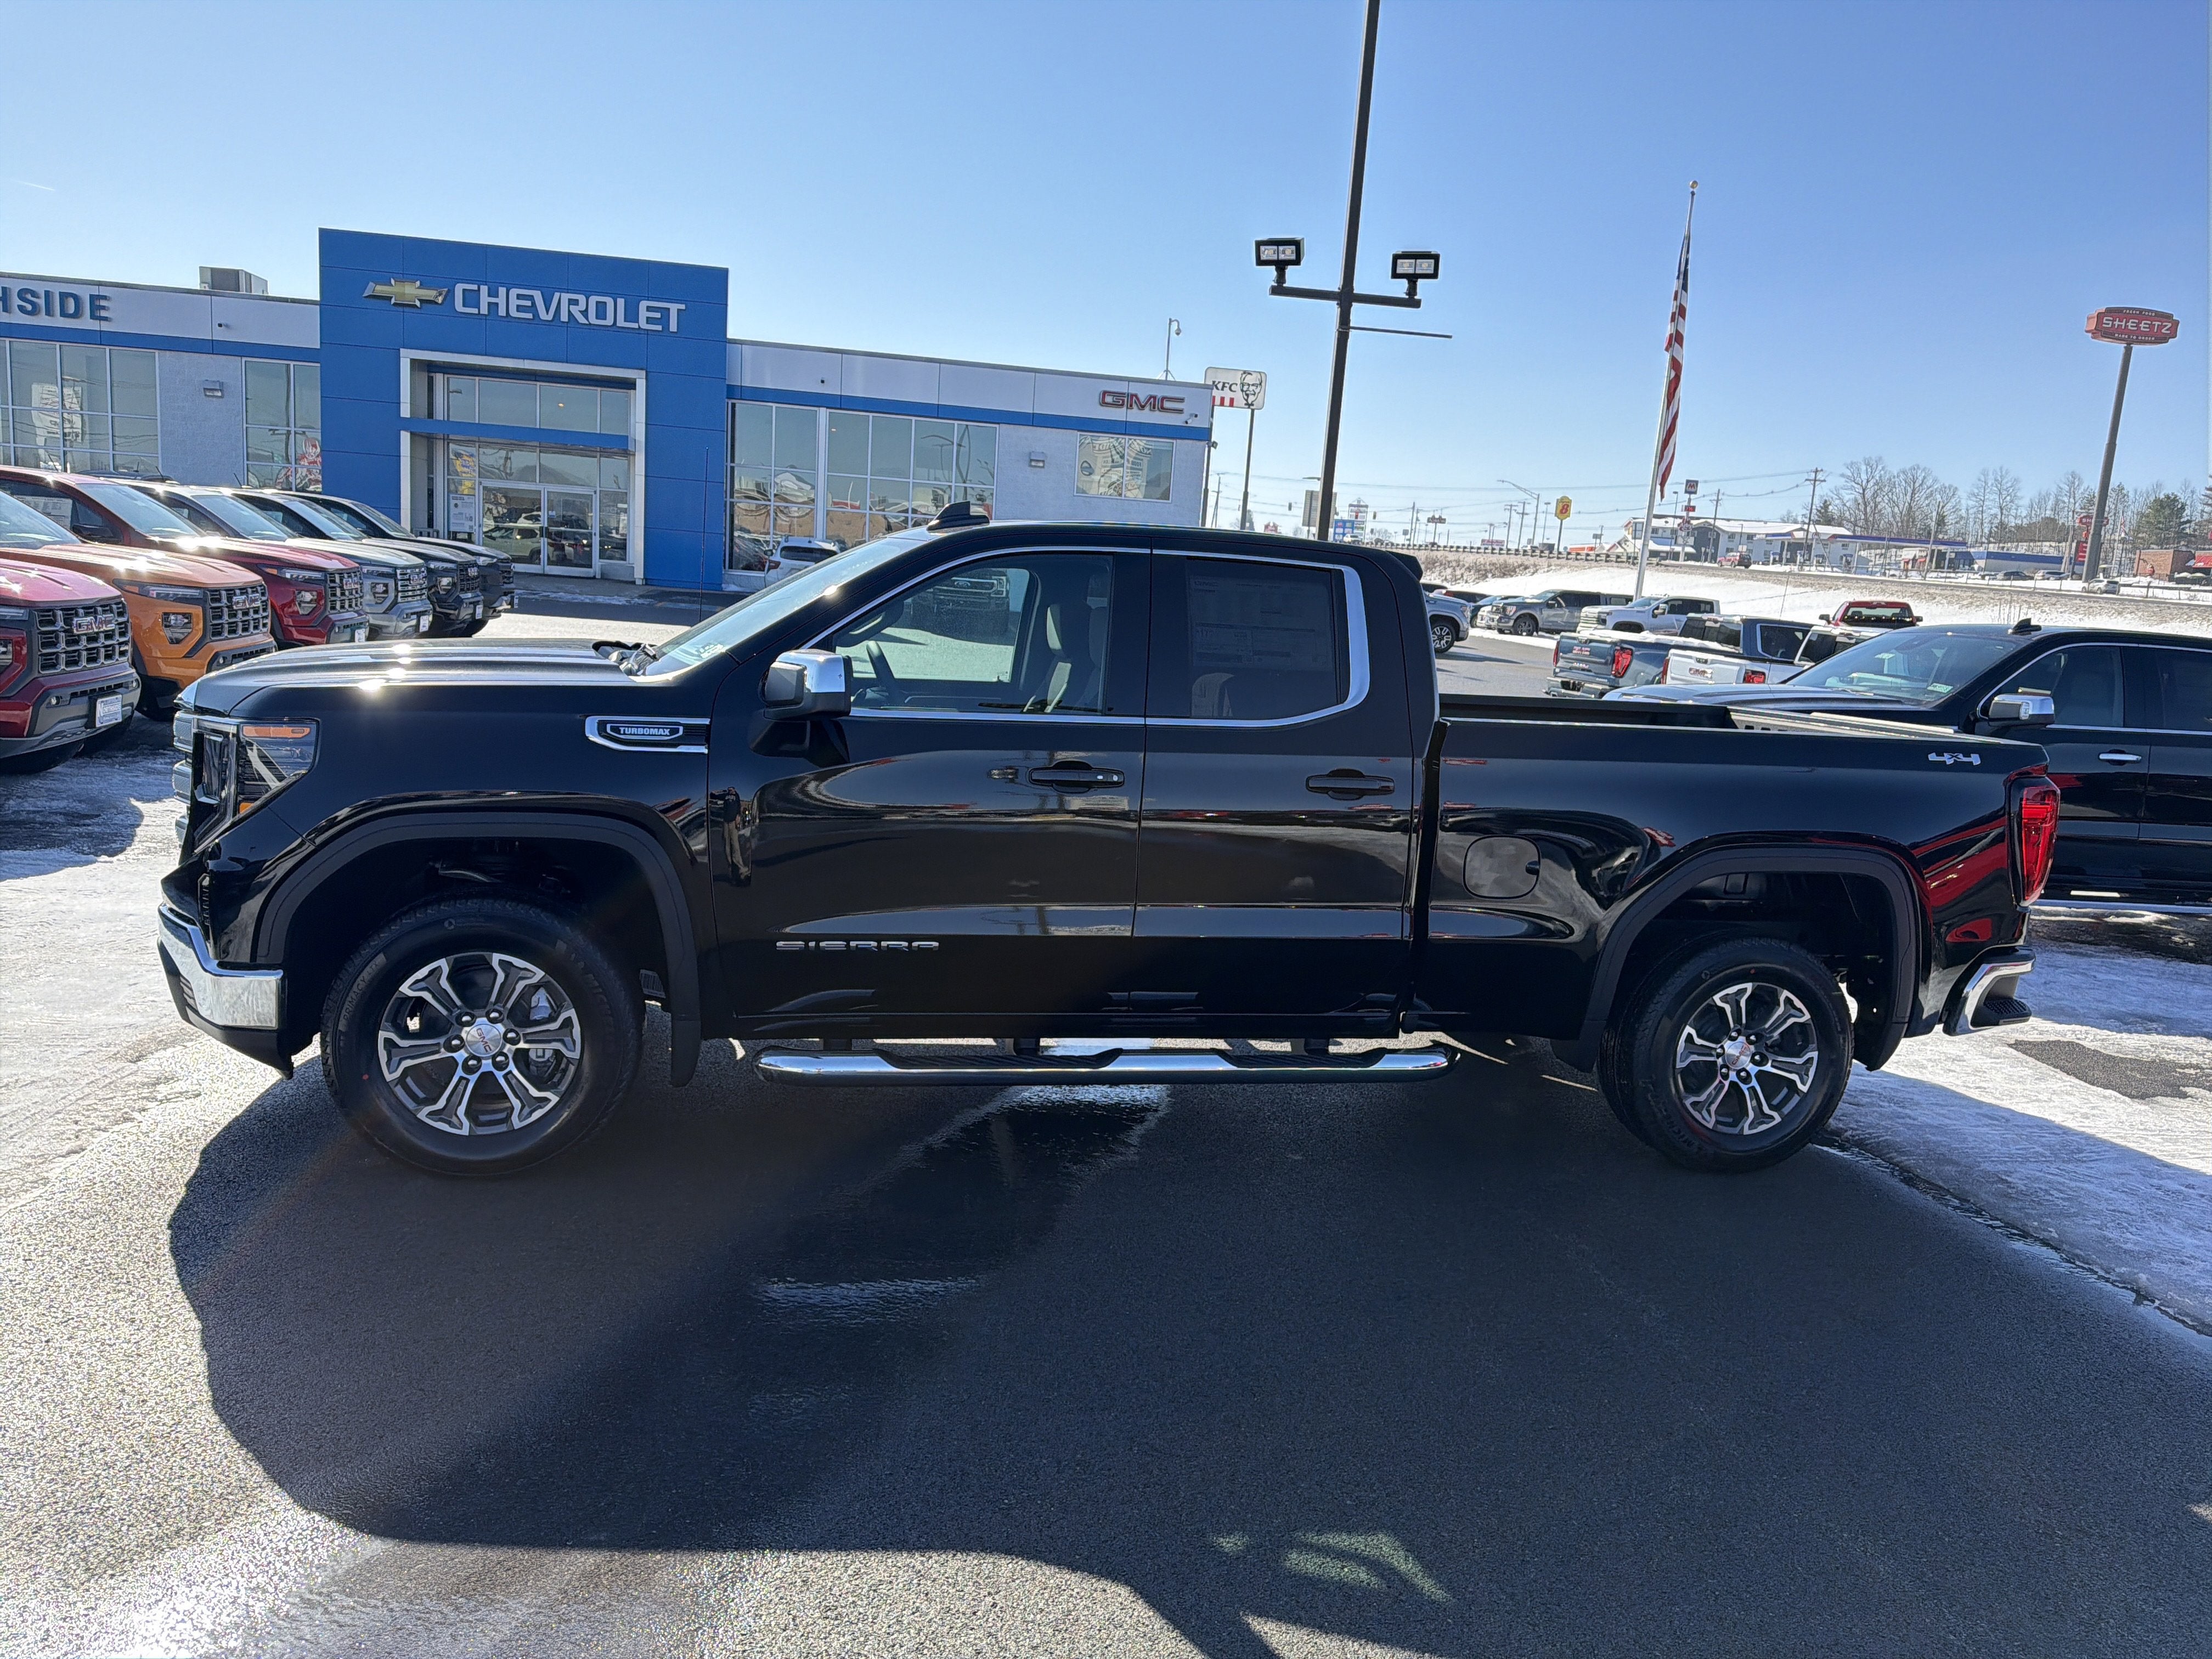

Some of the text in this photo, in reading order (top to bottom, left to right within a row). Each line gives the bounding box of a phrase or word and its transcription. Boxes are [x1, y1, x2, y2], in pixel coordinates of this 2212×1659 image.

[454, 283, 686, 332] CHEVROLET
[2102, 317, 2172, 334] SHEETZ
[1211, 380, 1238, 393] KFC
[1100, 390, 1185, 414] GMC
[72, 614, 115, 634] GMC
[619, 727, 670, 735] TURBOMAX
[776, 941, 939, 951] SIERRA
[343, 961, 379, 1020] PRIMACY LTX
[476, 1028, 492, 1053] GMC
[1732, 1045, 1748, 1065] GMC
